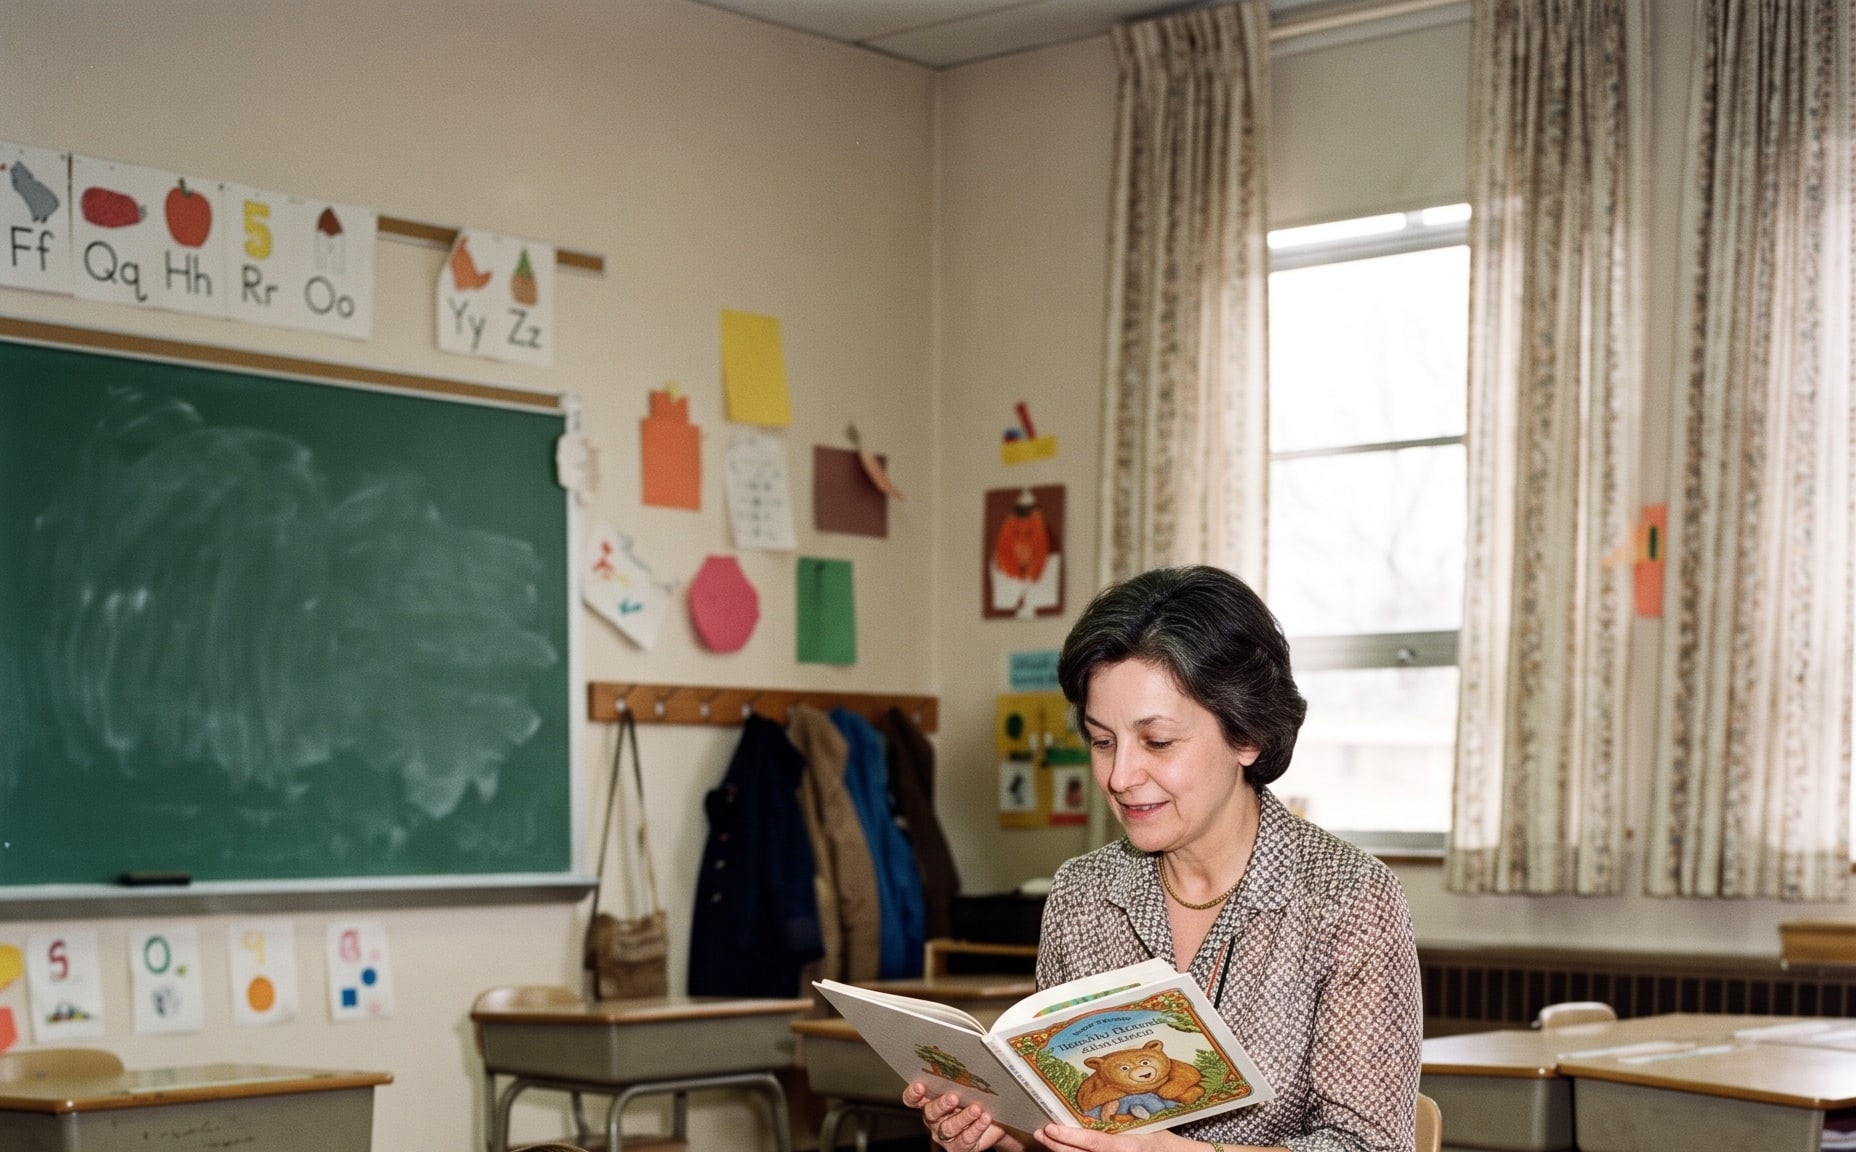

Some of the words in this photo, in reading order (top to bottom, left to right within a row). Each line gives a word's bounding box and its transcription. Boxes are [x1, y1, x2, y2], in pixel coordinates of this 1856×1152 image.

[243, 199, 272, 260] 5
[10, 225, 55, 272] Ff
[83, 240, 148, 302] Qq
[165, 250, 212, 297] Hh
[242, 264, 278, 306] Rr
[303, 276, 355, 318] Oo
[446, 296, 486, 351] Yy
[507, 307, 541, 350] Zz
